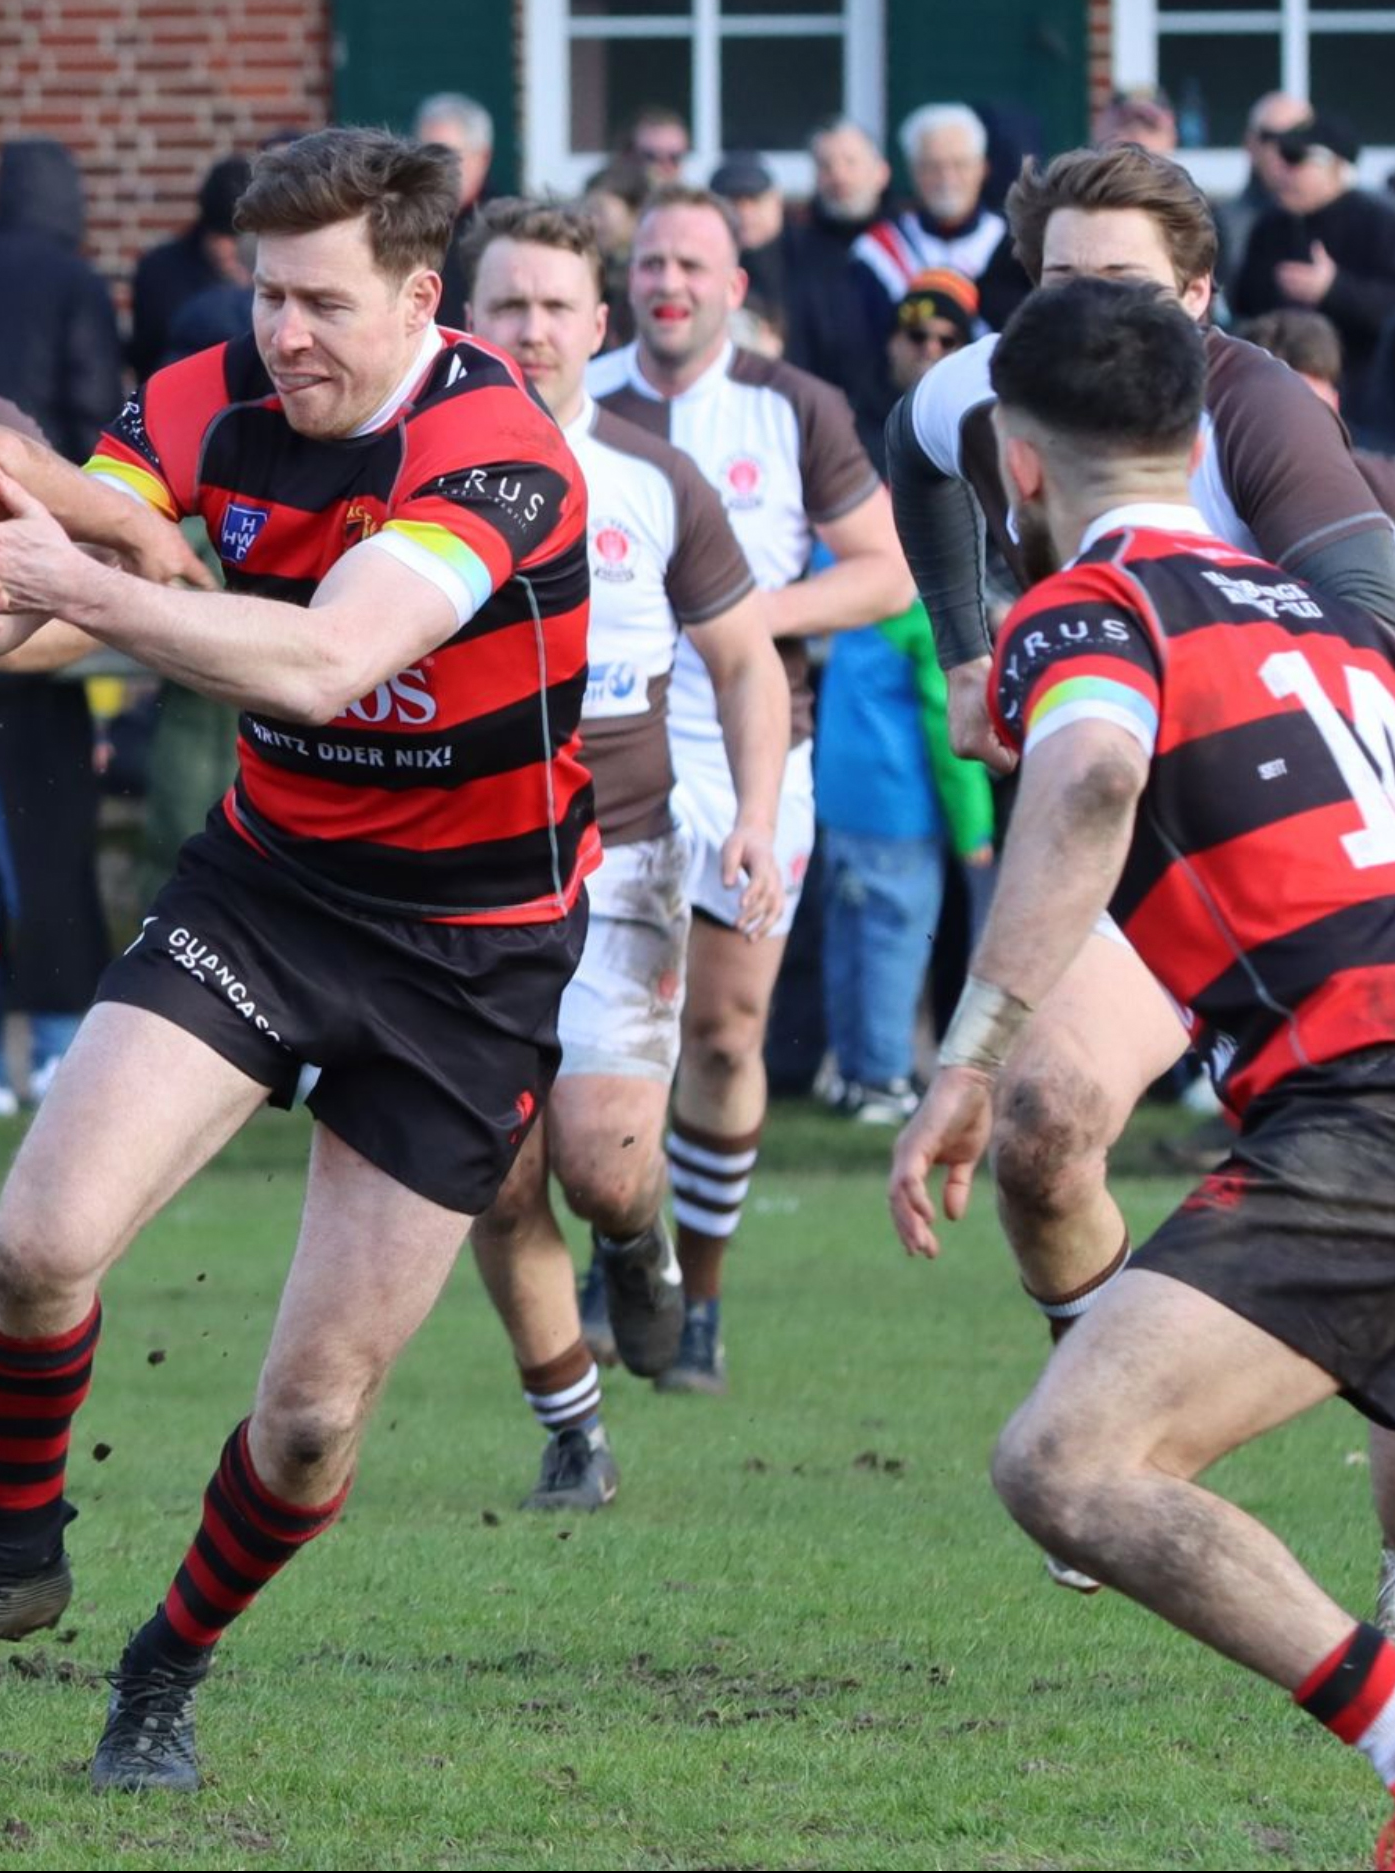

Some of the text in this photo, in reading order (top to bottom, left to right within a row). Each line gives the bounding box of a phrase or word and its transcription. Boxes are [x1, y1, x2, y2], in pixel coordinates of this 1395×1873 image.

[335, 668, 437, 725] OS
[317, 742, 385, 767] ODER
[395, 745, 452, 769] NIX!
[1257, 649, 1395, 869] 14
